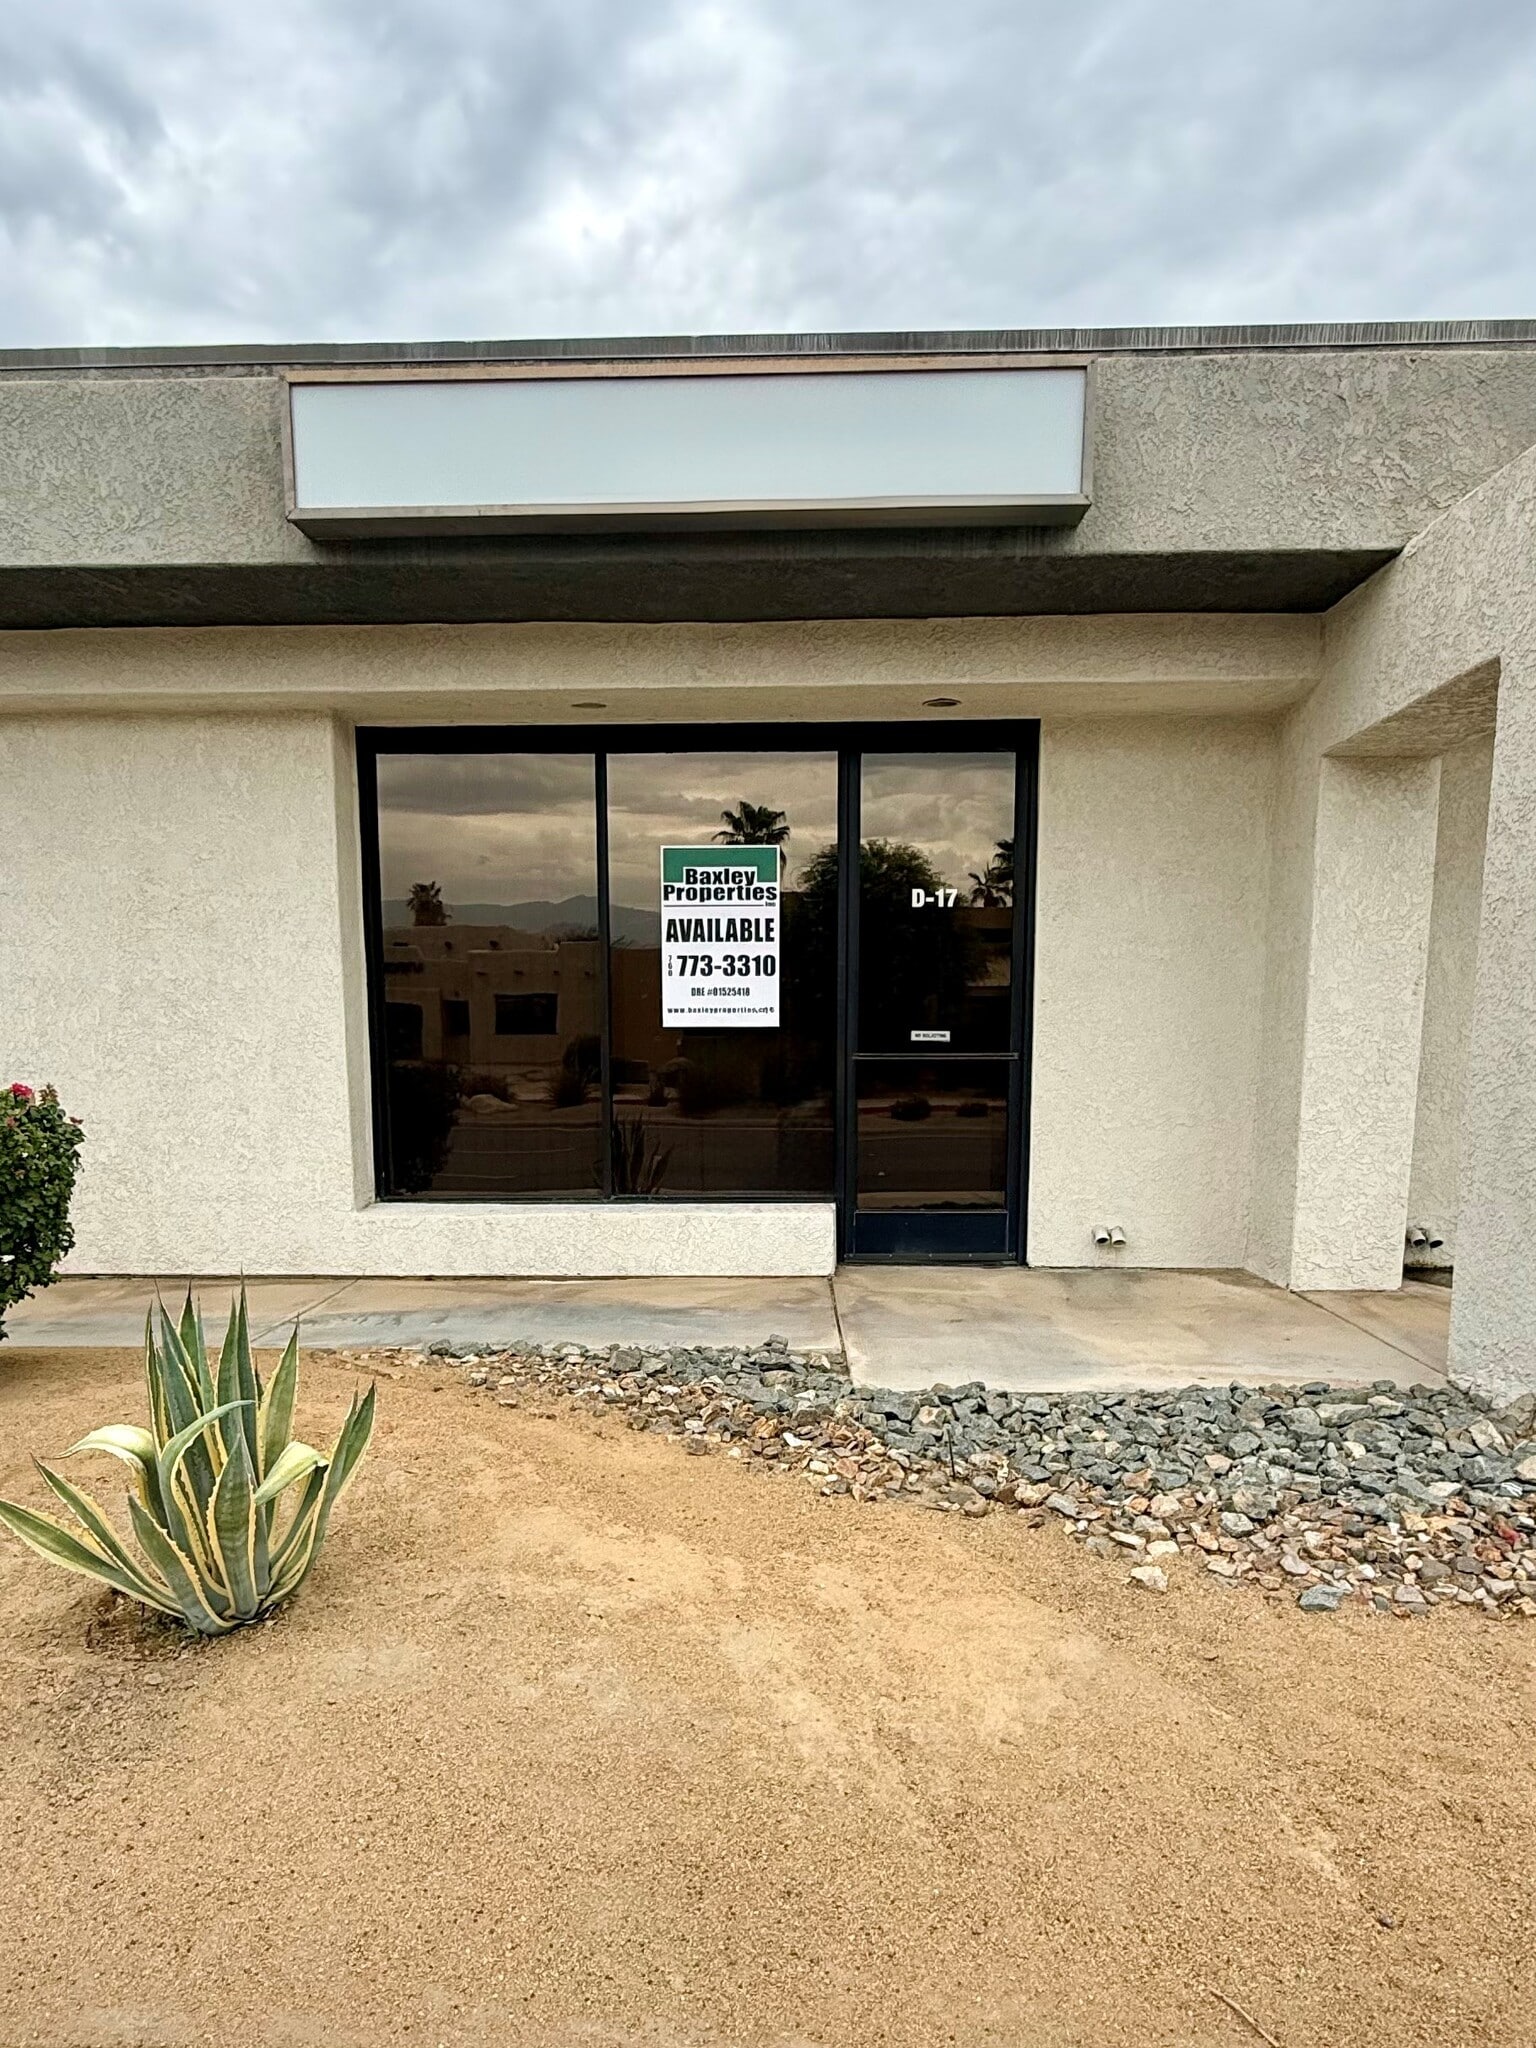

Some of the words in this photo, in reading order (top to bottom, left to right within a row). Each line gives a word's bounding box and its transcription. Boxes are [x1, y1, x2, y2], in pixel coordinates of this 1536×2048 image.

[685, 868, 755, 886] Baxley
[663, 885, 777, 902] Properties
[911, 888, 958, 908] D-17
[666, 918, 775, 943] AVAILABLE
[677, 954, 776, 977] 773-3310
[691, 987, 705, 997] DRE
[707, 987, 751, 997] #01525418
